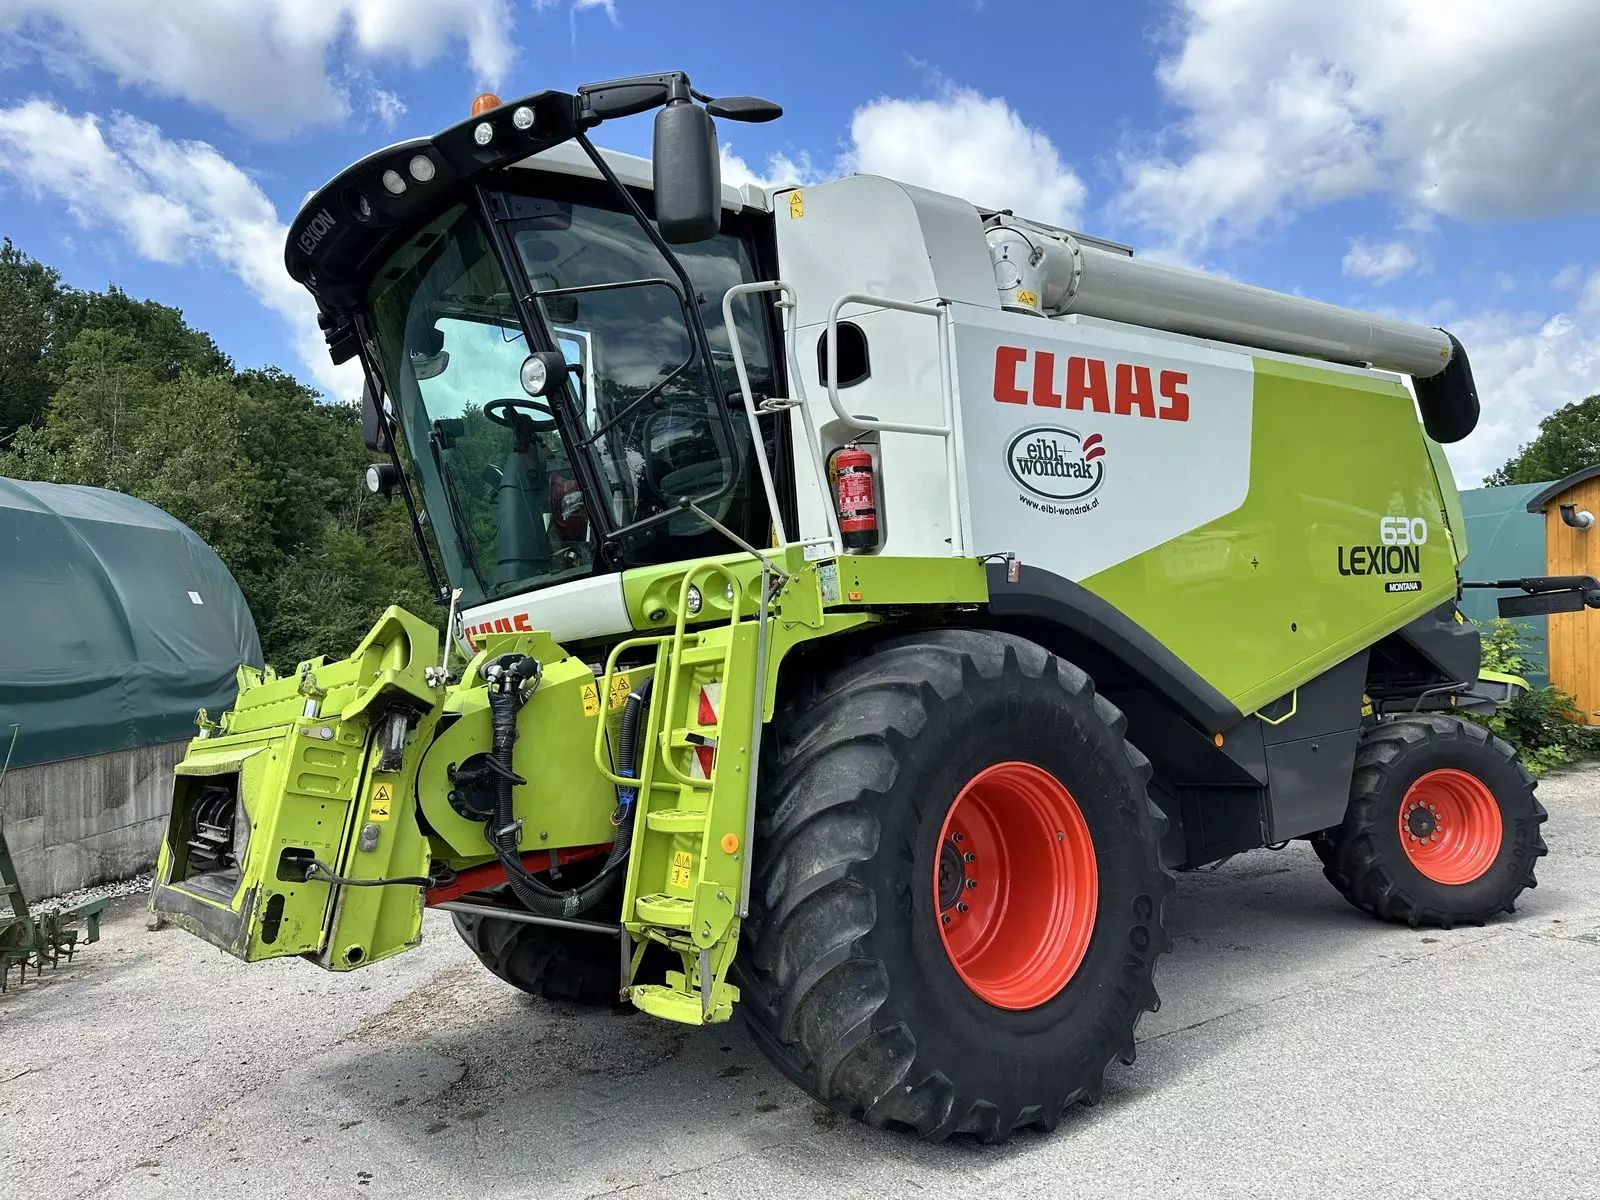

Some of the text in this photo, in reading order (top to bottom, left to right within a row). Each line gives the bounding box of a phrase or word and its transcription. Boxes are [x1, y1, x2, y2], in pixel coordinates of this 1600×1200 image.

[297, 208, 336, 256] LEXION
[993, 345, 1189, 422] CLAAS
[1016, 455, 1093, 479] wondrak
[1019, 494, 1099, 515] www.eibl-wondrak.at
[1380, 516, 1427, 545] 630
[1338, 545, 1420, 576] LEXION
[1389, 582, 1418, 592] MONTANA
